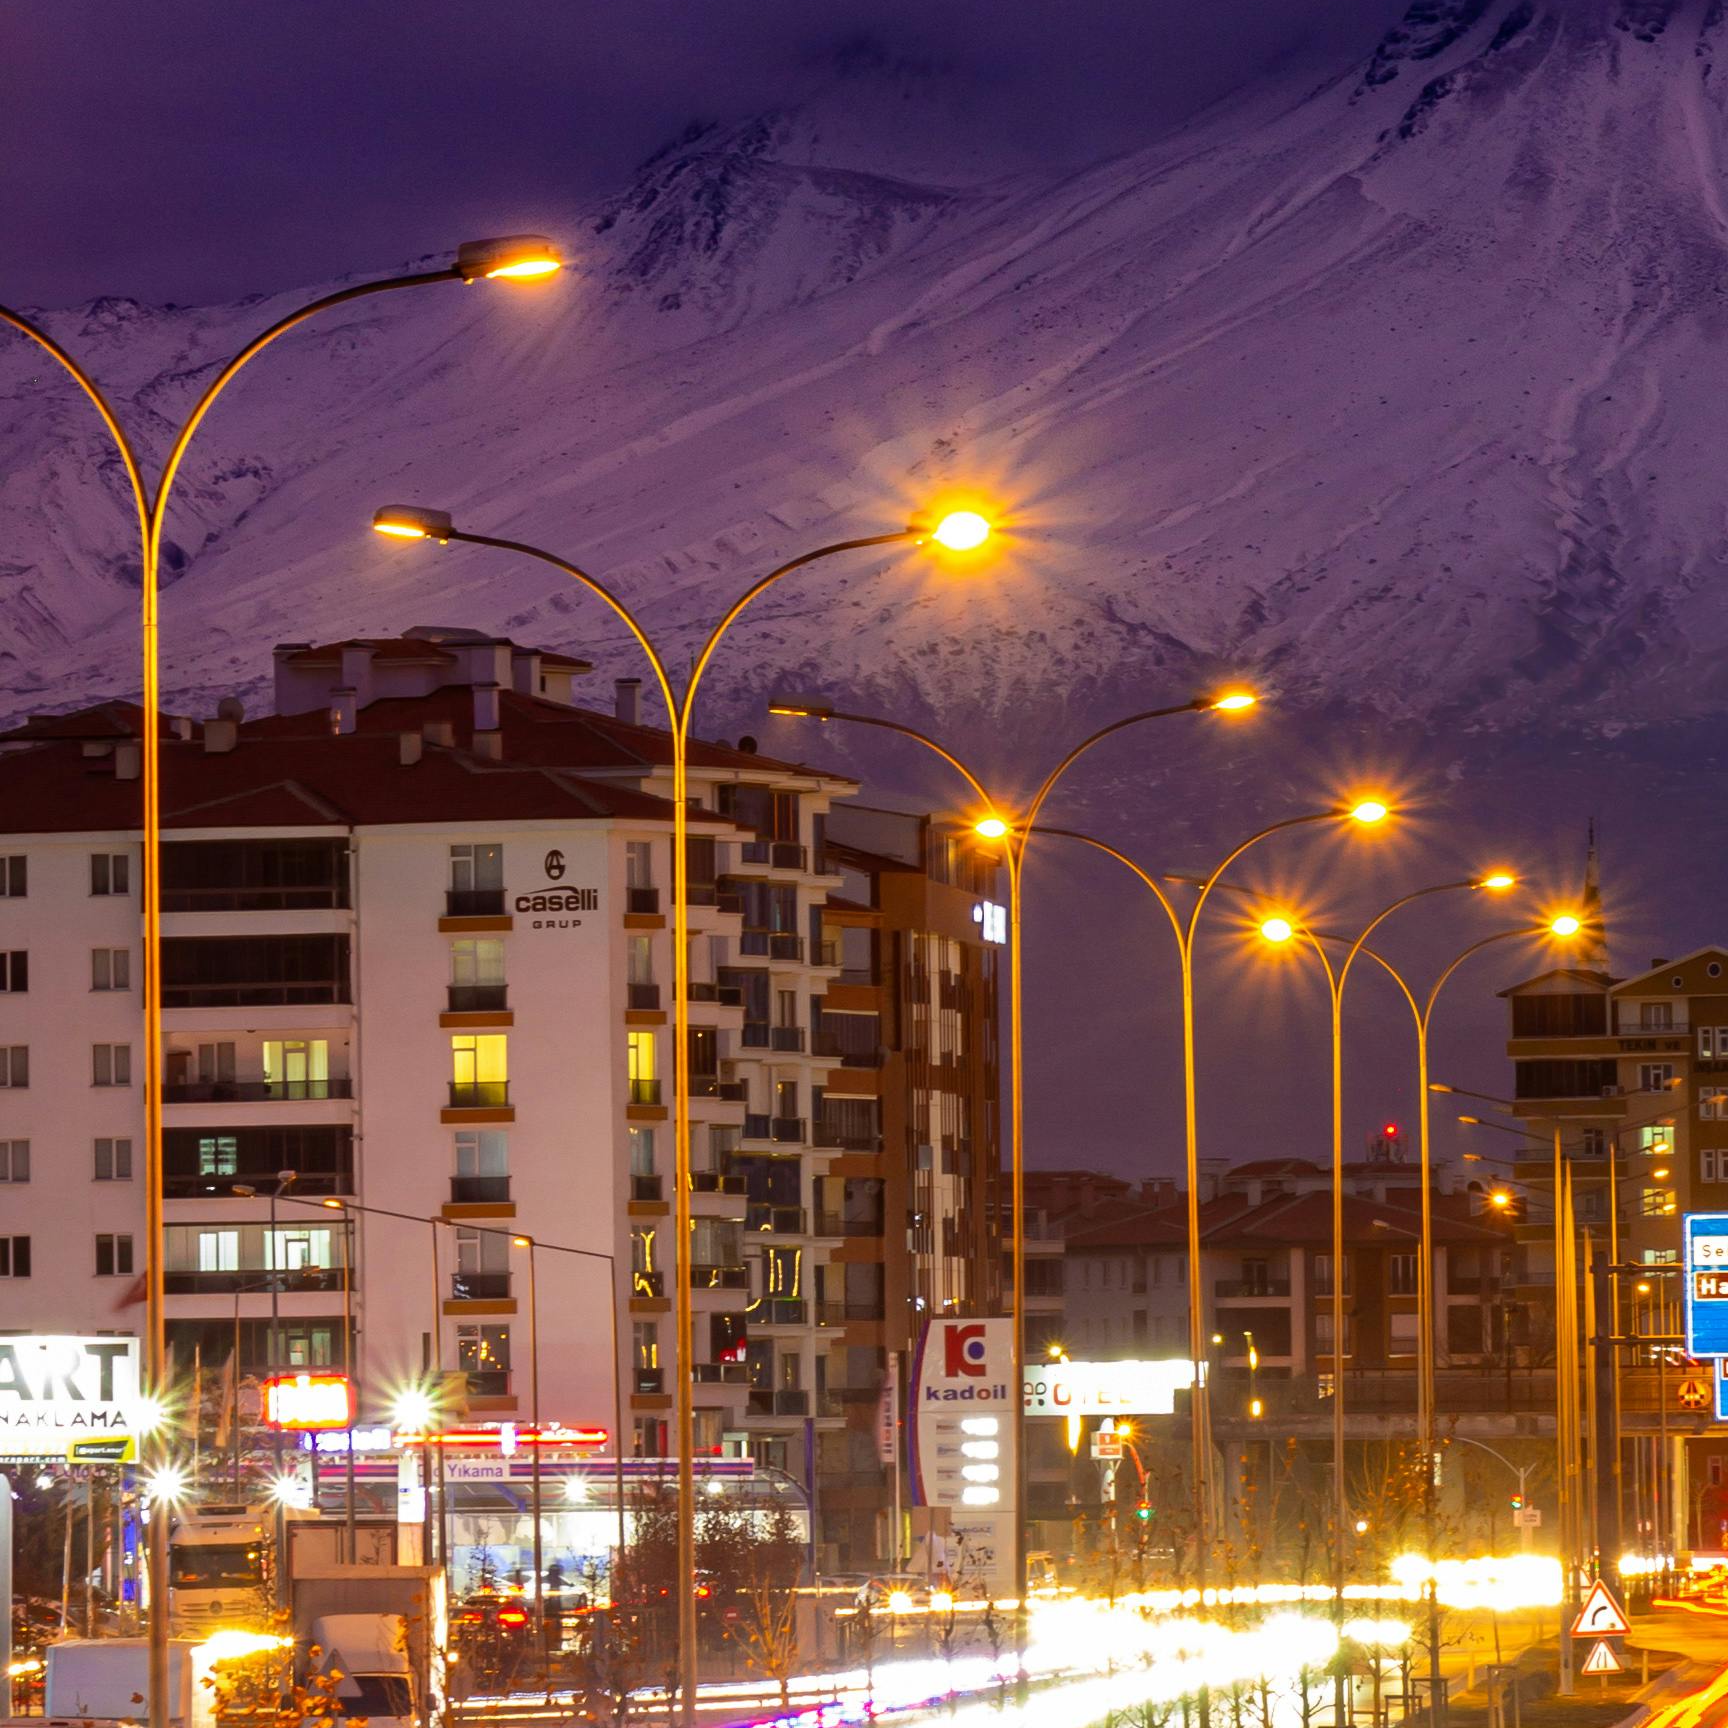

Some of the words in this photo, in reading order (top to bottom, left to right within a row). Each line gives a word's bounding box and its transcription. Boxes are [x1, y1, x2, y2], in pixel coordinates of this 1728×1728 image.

[515, 887, 599, 913] caselli
[533, 920, 582, 929] GRUP
[926, 1384, 1007, 1401] kadoil
[1053, 1383, 1133, 1406] OEL
[447, 1463, 504, 1479] Yıkama
